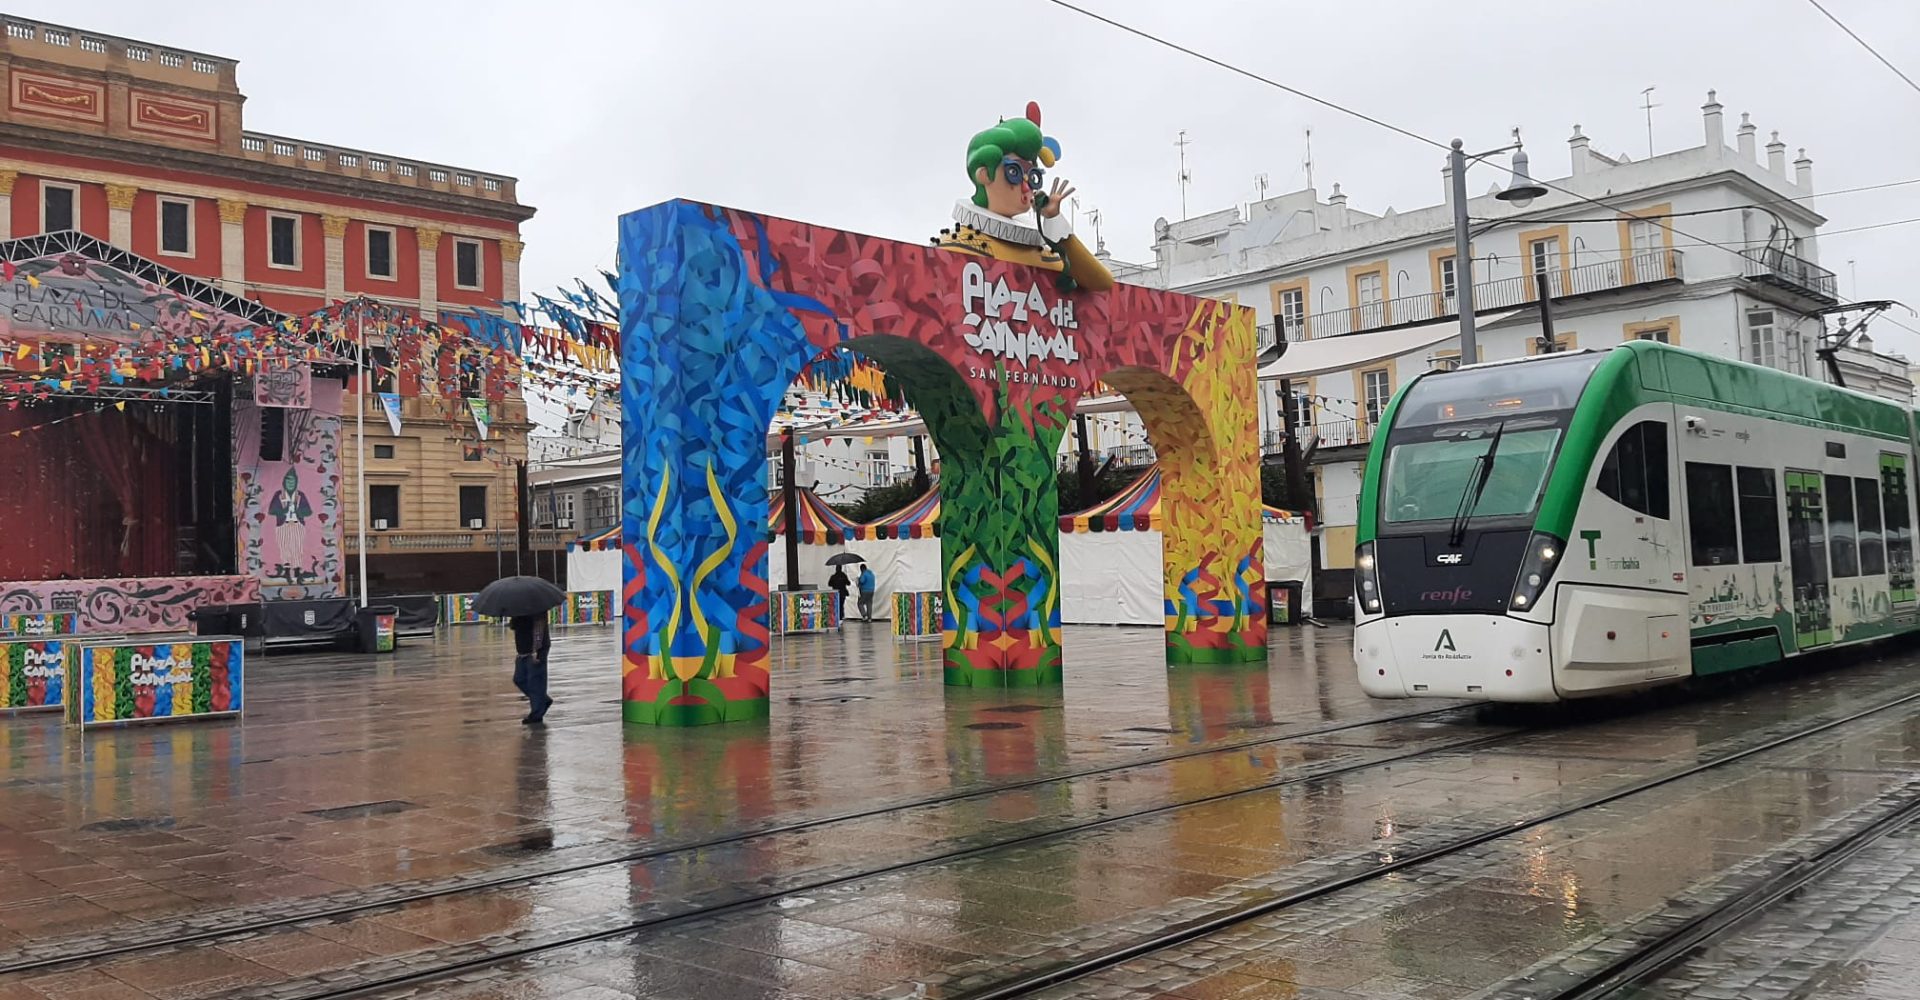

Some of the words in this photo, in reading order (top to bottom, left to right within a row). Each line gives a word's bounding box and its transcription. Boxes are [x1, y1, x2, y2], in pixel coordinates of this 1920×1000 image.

[15, 283, 93, 308] PLAZA
[962, 262, 1048, 321] PLAZA
[963, 313, 1079, 370] CARNAVAL
[970, 366, 997, 381] SAN
[1005, 372, 1077, 388] FERNANDO
[1436, 553, 1463, 564] CAF
[1420, 585, 1473, 605] renfe
[130, 653, 177, 672] PLAZA
